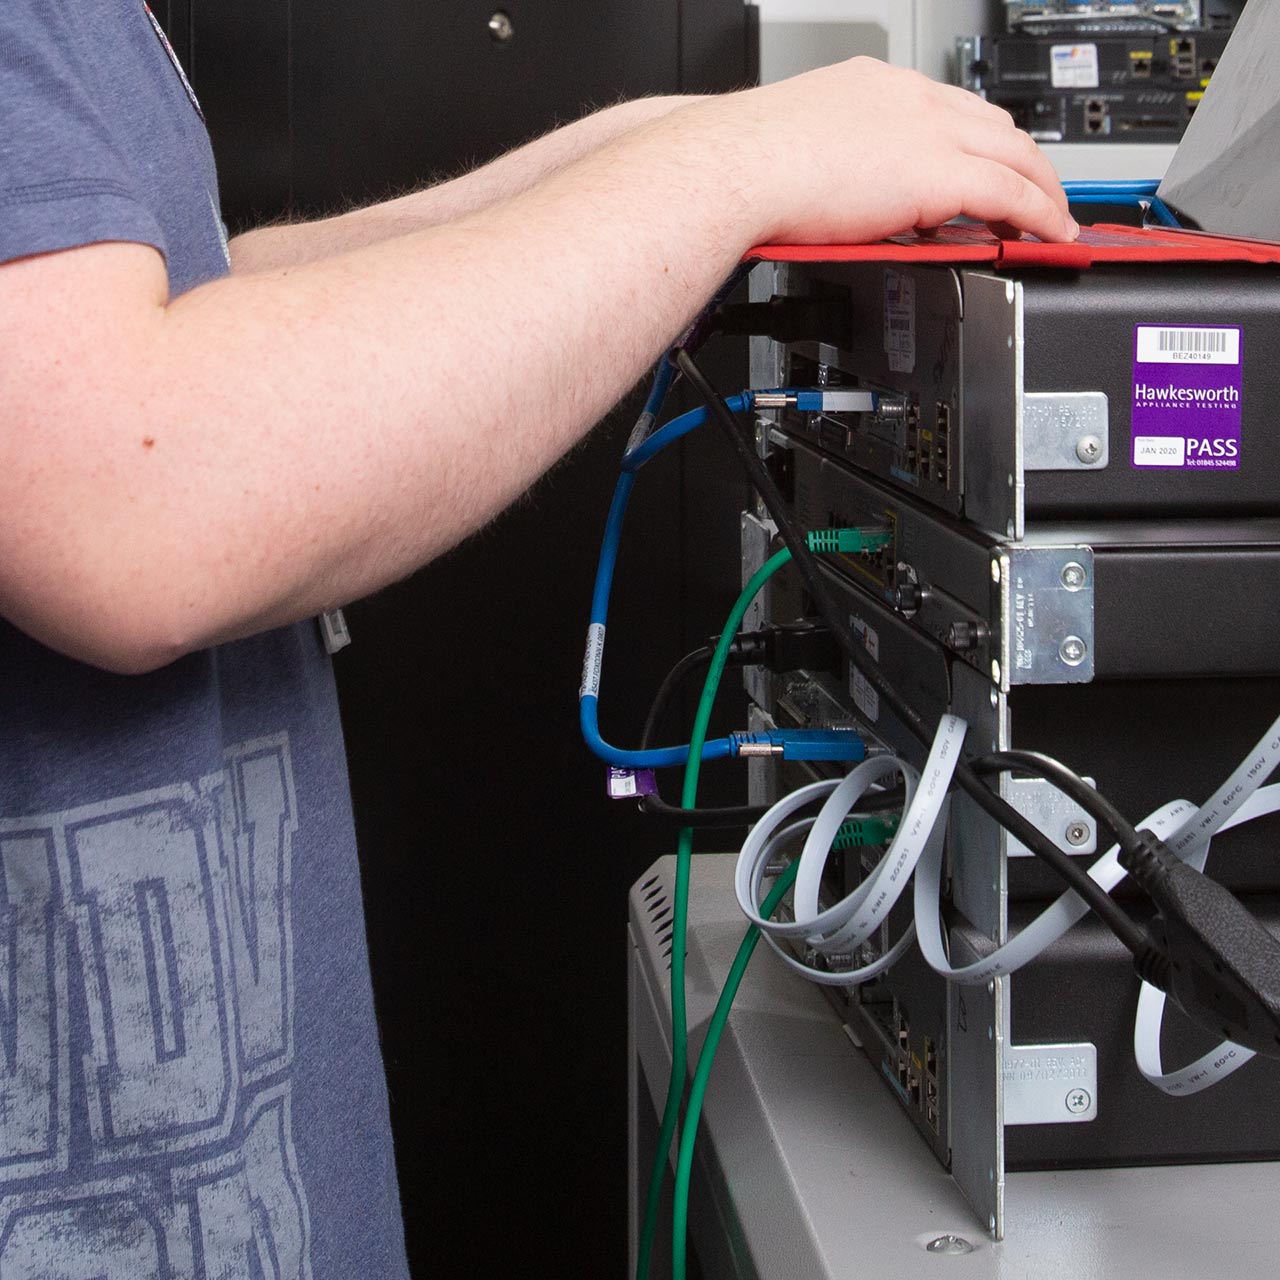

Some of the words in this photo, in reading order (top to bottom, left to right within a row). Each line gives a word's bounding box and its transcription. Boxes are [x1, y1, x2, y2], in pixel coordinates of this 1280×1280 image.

[1135, 384, 1238, 401] Hawkesworth
[1140, 447, 1157, 455] JAN
[1159, 447, 1177, 455] 2020
[1186, 438, 1237, 457] PASS
